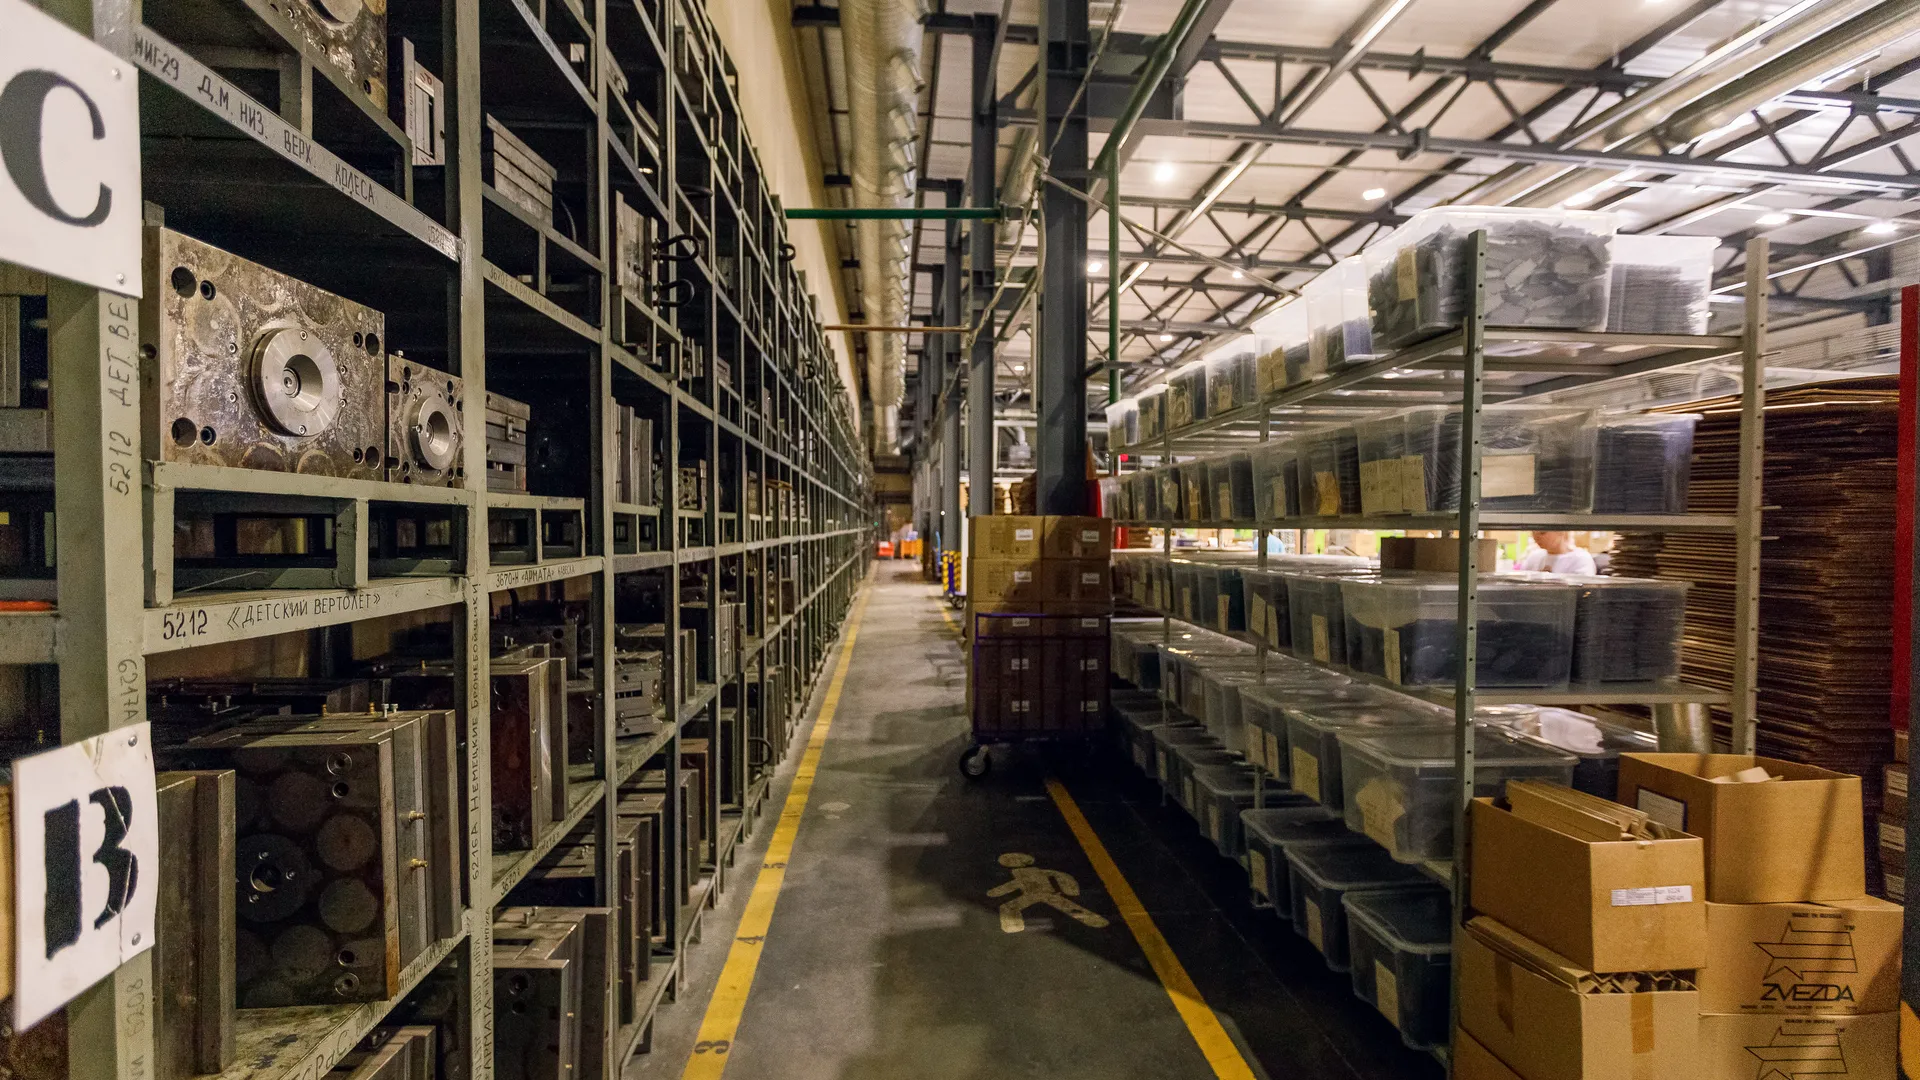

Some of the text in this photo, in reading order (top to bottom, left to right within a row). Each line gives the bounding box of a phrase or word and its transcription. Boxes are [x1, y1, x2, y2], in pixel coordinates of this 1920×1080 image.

[283, 129, 316, 169] ВЕРХ.
[335, 162, 375, 205] КОЛЕСА
[108, 296, 130, 341] ВЕ
[109, 430, 132, 496] 5212
[521, 567, 555, 585] «АРМАТА»
[163, 593, 381, 640] 5212 «ДЕТСКИЙ ВЕРТОЛЕТ»
[1760, 983, 1856, 1002] ZVEZDA
